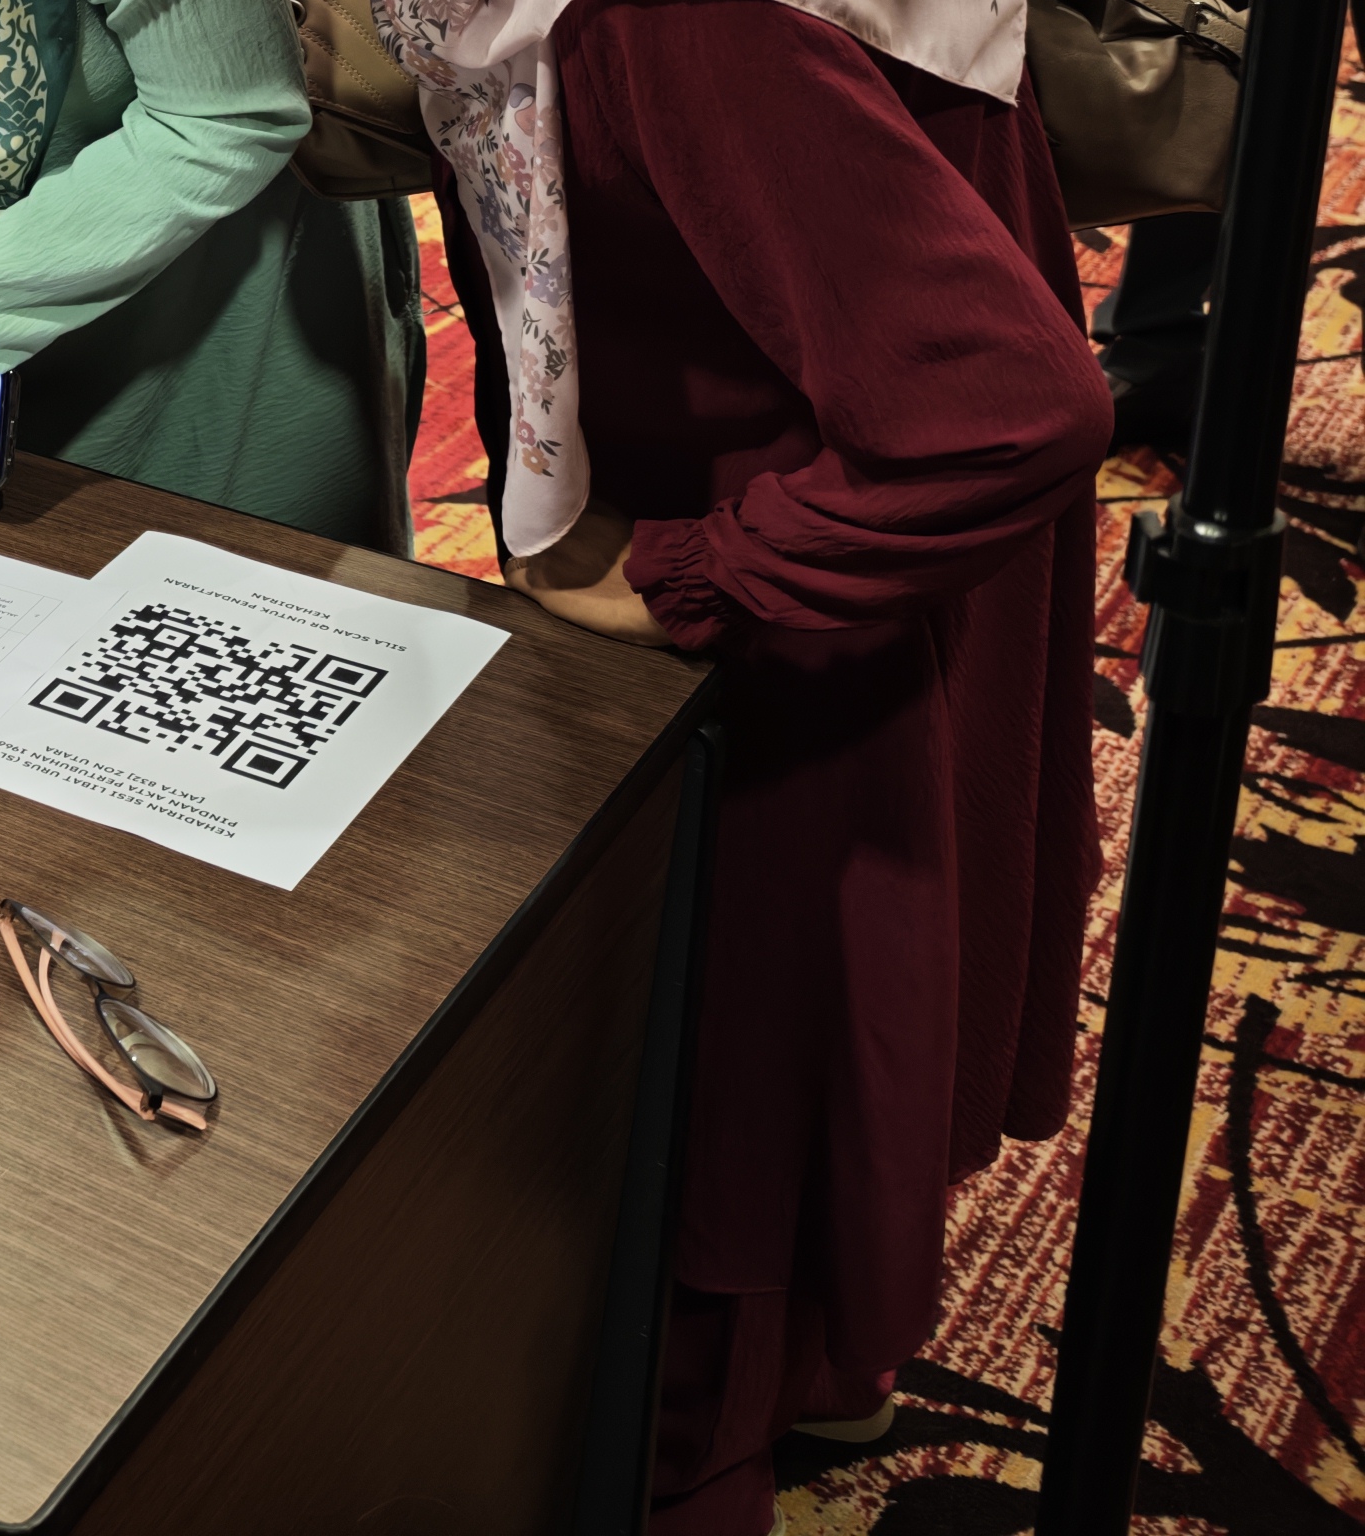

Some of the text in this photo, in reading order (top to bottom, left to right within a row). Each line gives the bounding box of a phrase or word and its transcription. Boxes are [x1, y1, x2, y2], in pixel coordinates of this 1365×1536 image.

[163, 576, 407, 652] SILA SCAN QR UNTUK PENDAFTARAN
[249, 592, 331, 619] KEHADIRAN
[21, 760, 61, 777] URUS
[28, 751, 124, 788] PERTUBUHAN
[42, 745, 206, 804] [AKTA 832] ZON UTARA
[61, 774, 107, 793] LIBAT
[108, 789, 144, 806] SESI
[125, 784, 166, 801] AKTA
[144, 802, 236, 838] KEHADIRAN
[166, 798, 238, 827] PINDAAN
